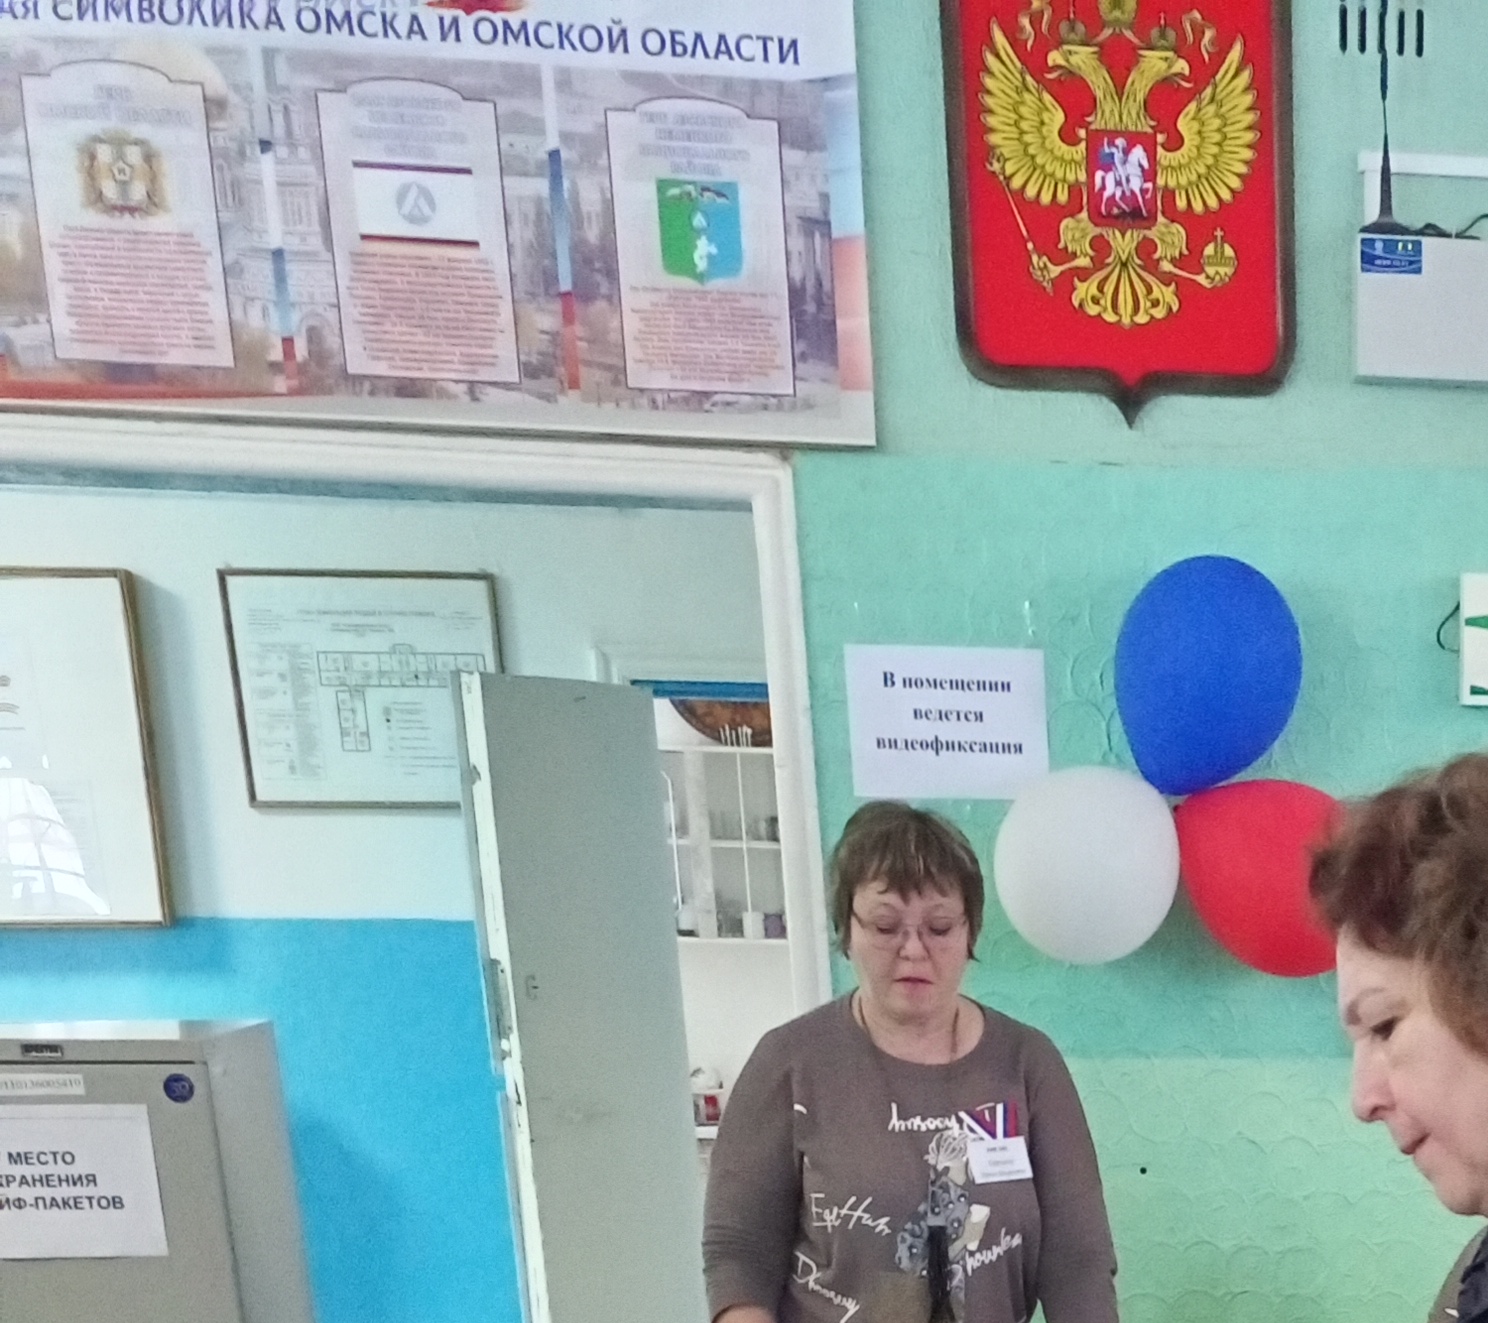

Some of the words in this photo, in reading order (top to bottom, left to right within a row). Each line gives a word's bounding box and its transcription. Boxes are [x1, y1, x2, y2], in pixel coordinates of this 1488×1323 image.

[52, 0, 285, 32] СИМВОЛИКА
[295, 6, 428, 40] ОМСКА
[438, 15, 461, 42] И
[473, 16, 629, 54] ОМСКОЙ
[641, 28, 801, 65] ОБЛАСТИ
[882, 671, 896, 689] В
[902, 676, 1011, 693] помещении
[913, 707, 984, 723] ведется
[876, 735, 1023, 756] видеофиксация
[7, 1151, 76, 1166] МЕСТО
